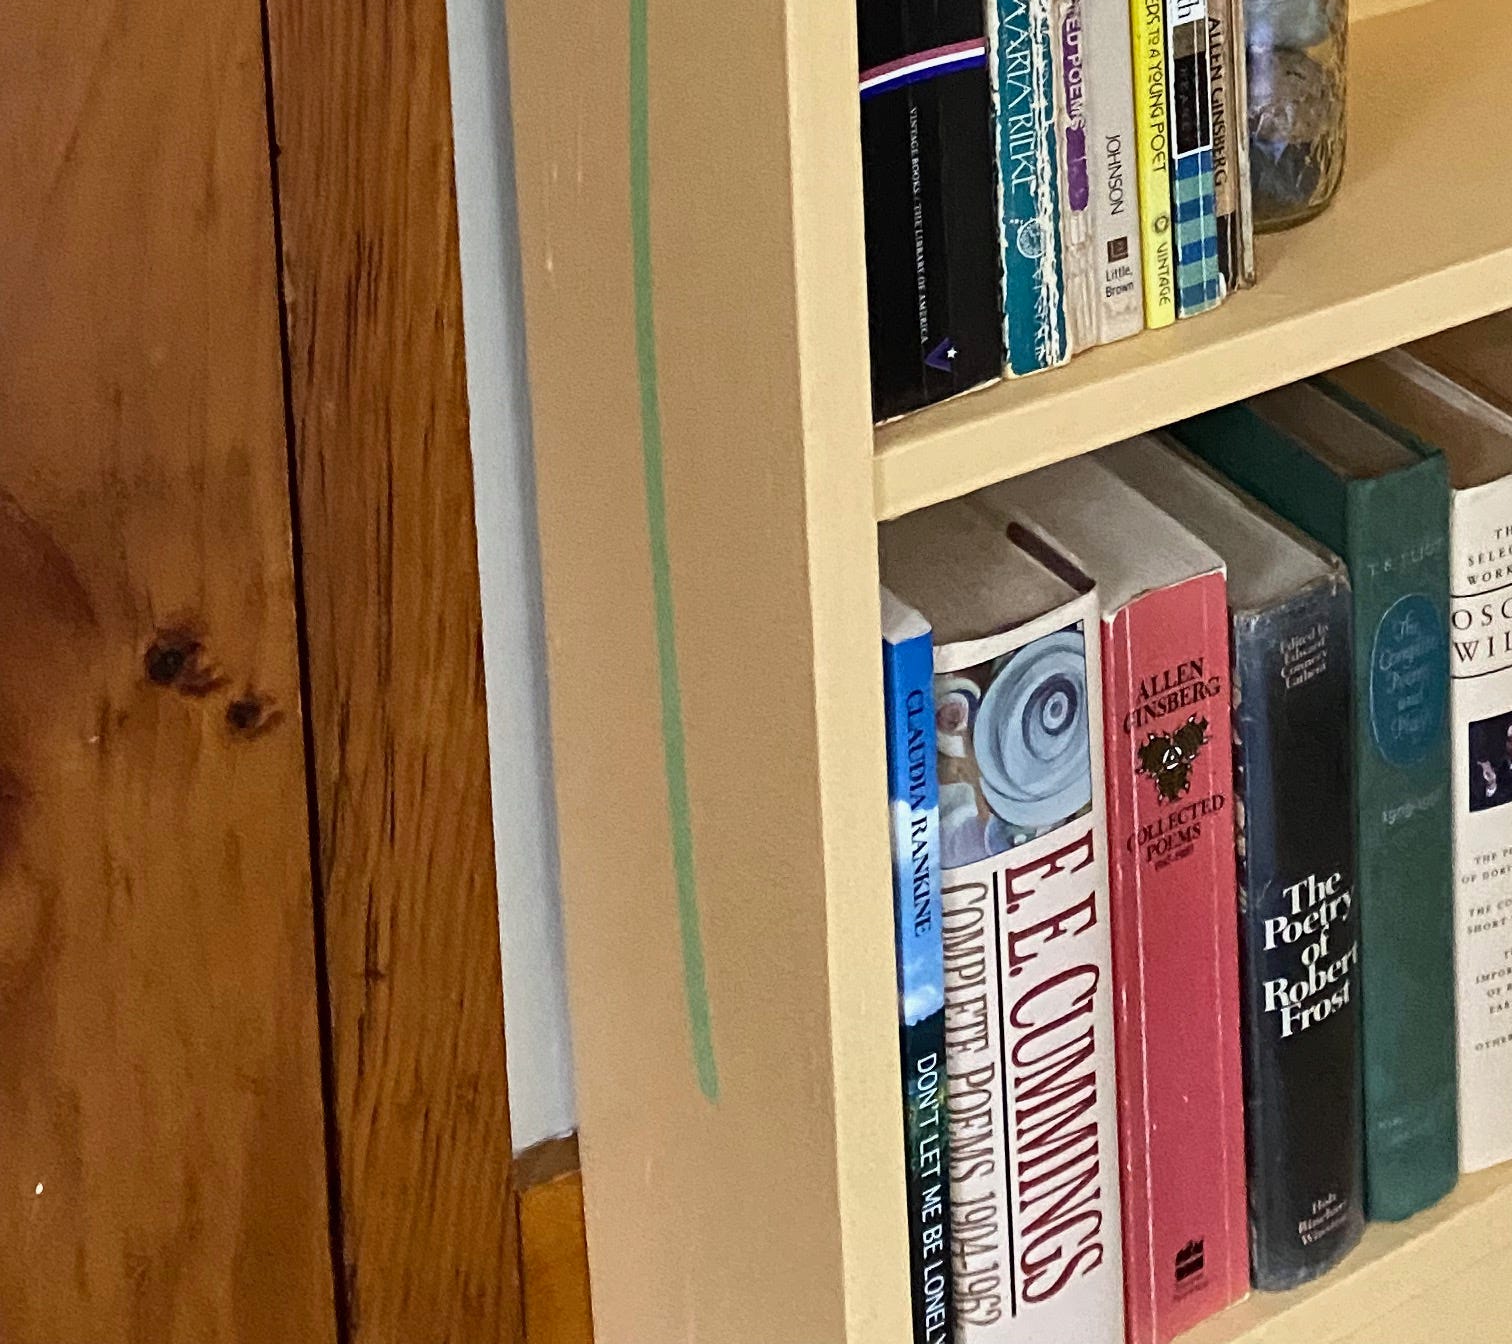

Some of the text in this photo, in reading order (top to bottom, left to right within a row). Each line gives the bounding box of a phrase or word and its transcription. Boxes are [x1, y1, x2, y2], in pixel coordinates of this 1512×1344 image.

[1148, 29, 1160, 44] TO
[1149, 48, 1159, 59] A
[1149, 63, 1164, 119] YOUNG
[1151, 123, 1166, 173] POET
[1105, 135, 1124, 214] JOHNSON
[1125, 678, 1222, 734] GINSBERG
[1135, 658, 1205, 706] ALLEN
[906, 689, 931, 938] CLAUDIA RANKINE
[1282, 872, 1341, 915] The
[1263, 888, 1354, 951] Poetry
[1302, 928, 1329, 968] of
[1262, 944, 1358, 1013] Robert
[1280, 985, 1351, 1038] Frost
[916, 1053, 939, 1129] DON'T
[1004, 828, 1103, 1304] E. E. CUMMINGS
[920, 1134, 940, 1176] LET
[921, 1184, 942, 1222] ME
[923, 1225, 943, 1260] BE
